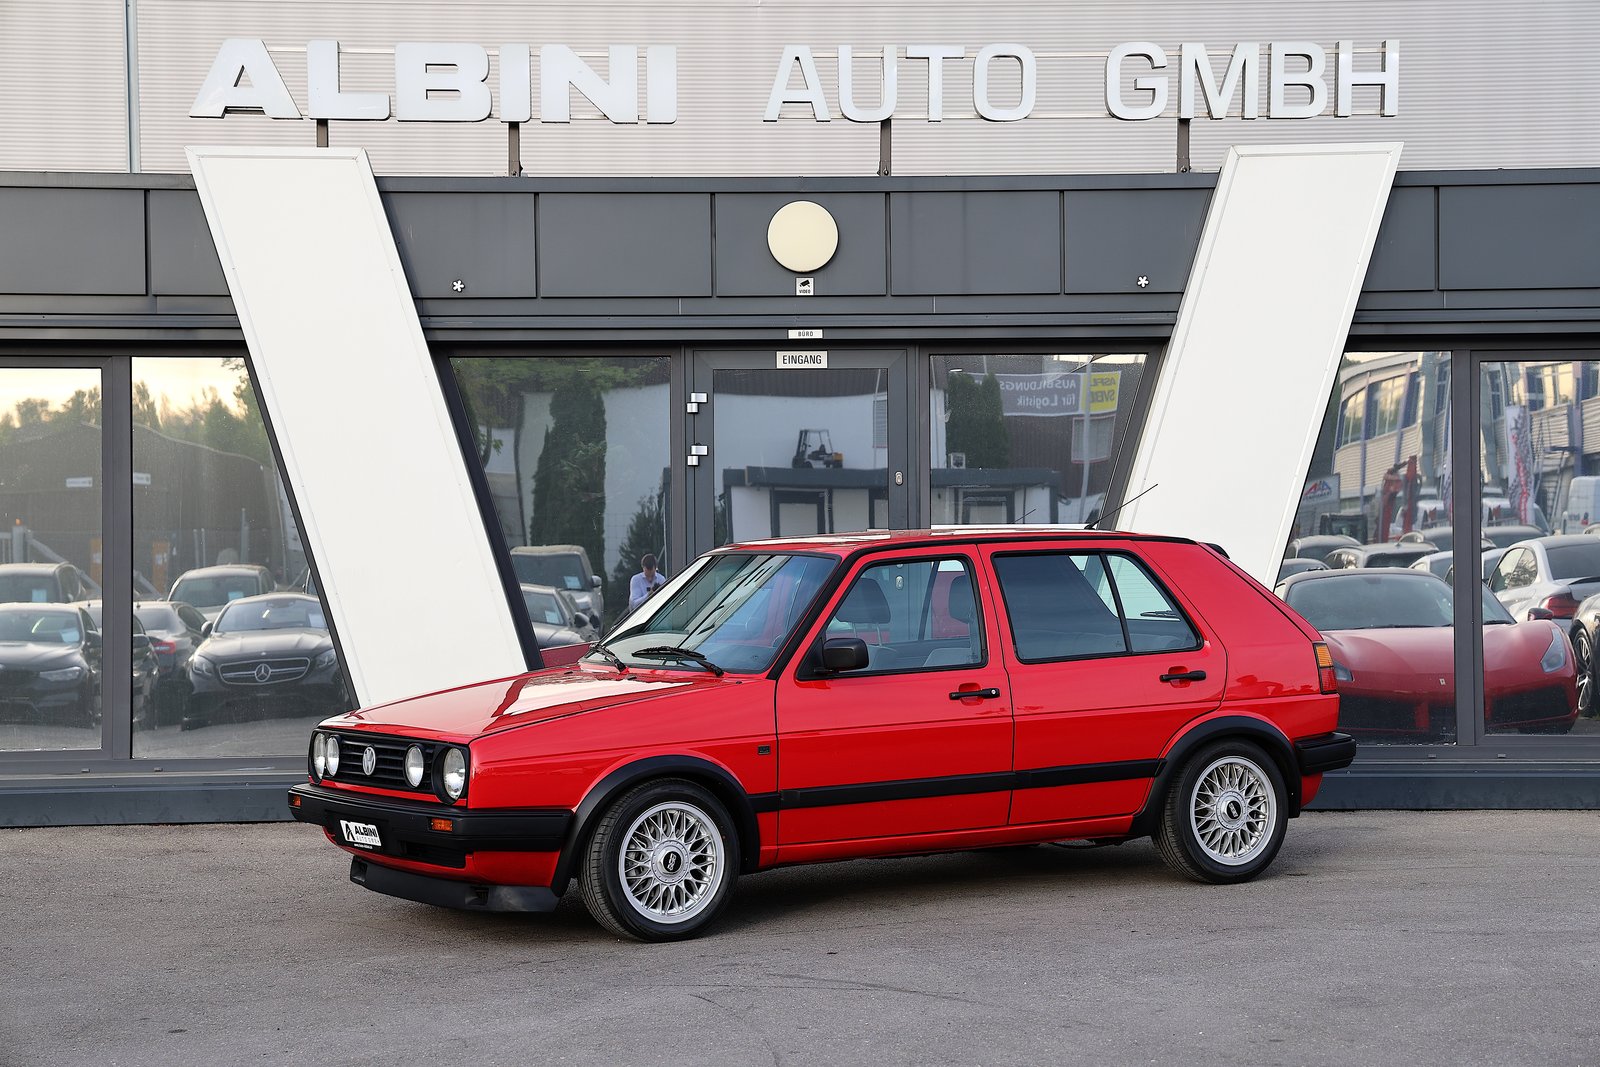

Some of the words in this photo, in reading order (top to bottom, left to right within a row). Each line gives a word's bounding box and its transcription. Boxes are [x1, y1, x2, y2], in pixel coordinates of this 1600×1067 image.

[188, 38, 677, 124] ALBINI
[762, 42, 1036, 123] AUTO
[1104, 39, 1401, 121] GMBH
[782, 354, 822, 364] EINGANG
